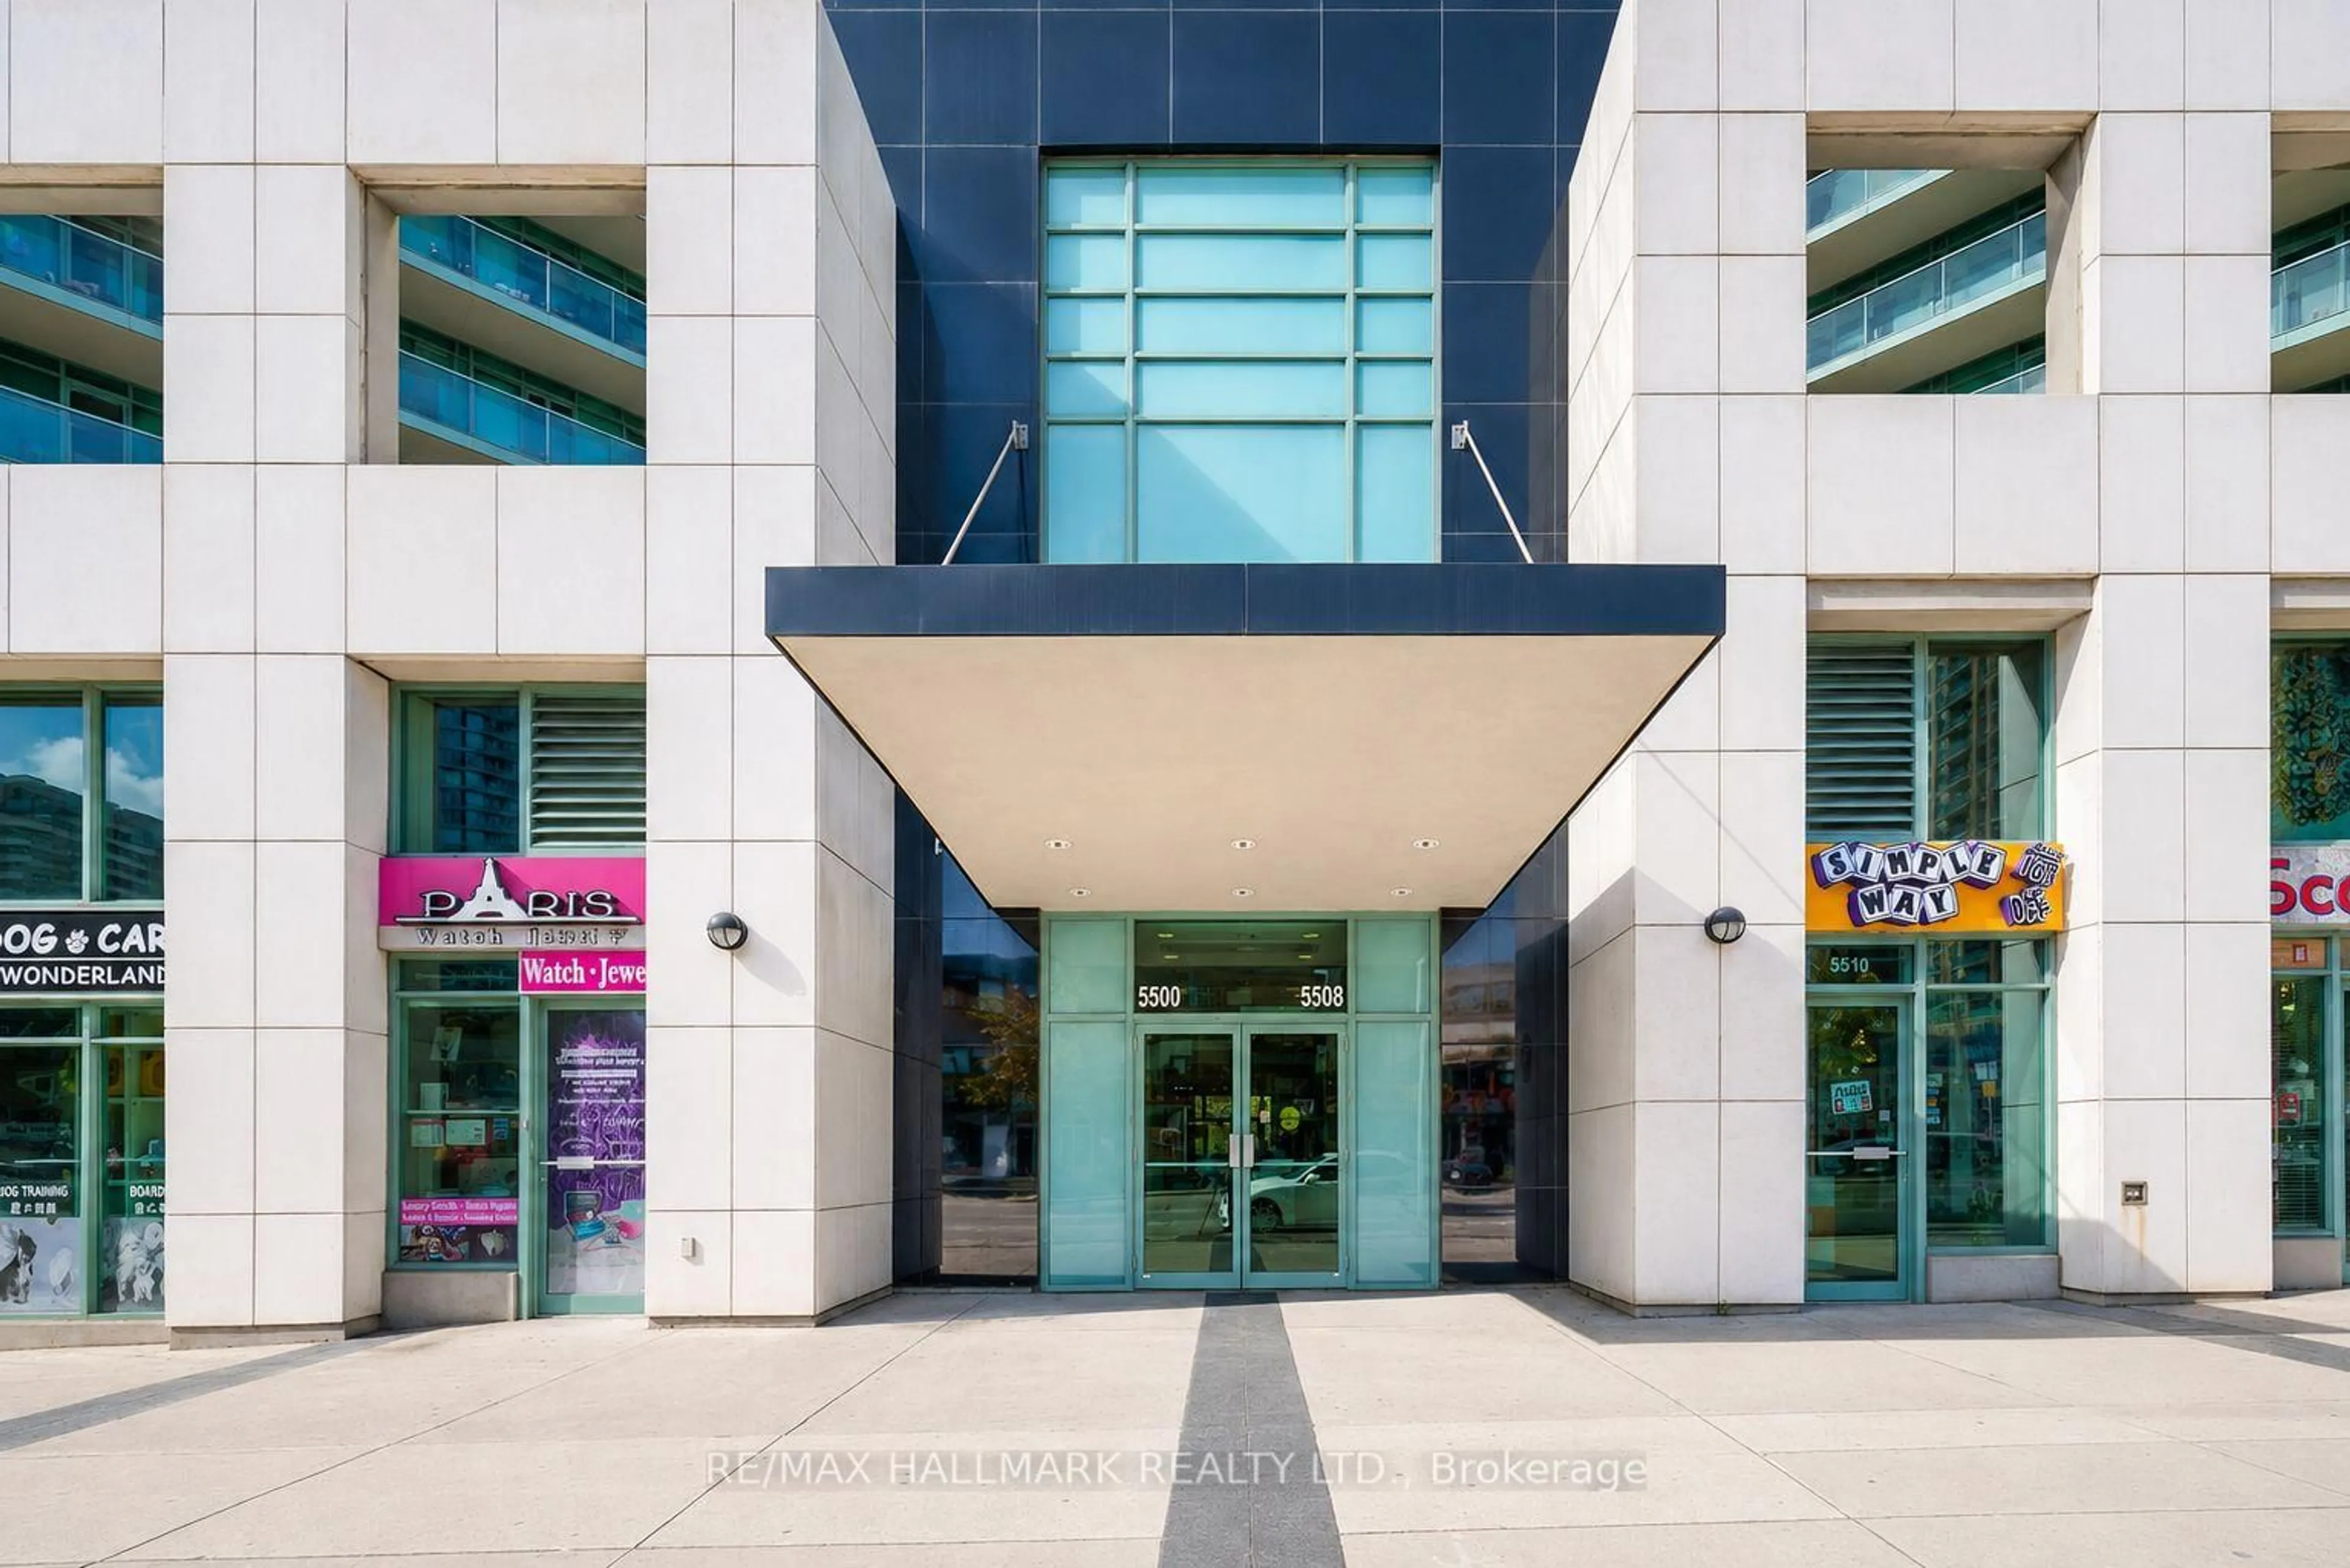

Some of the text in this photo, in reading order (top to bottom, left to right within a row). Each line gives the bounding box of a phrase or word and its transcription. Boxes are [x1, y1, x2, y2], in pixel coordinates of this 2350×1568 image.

[1827, 849, 1997, 876] SIMPLE
[420, 857, 614, 917] PARIS
[1860, 889, 1947, 915] WAY
[0, 923, 58, 954] OG
[521, 957, 586, 984] Watch
[1829, 957, 1870, 974] 5510
[1138, 985, 1181, 1007] 5500
[1300, 985, 1344, 1007] 5508
[21, 1184, 69, 1198] TRAINING
